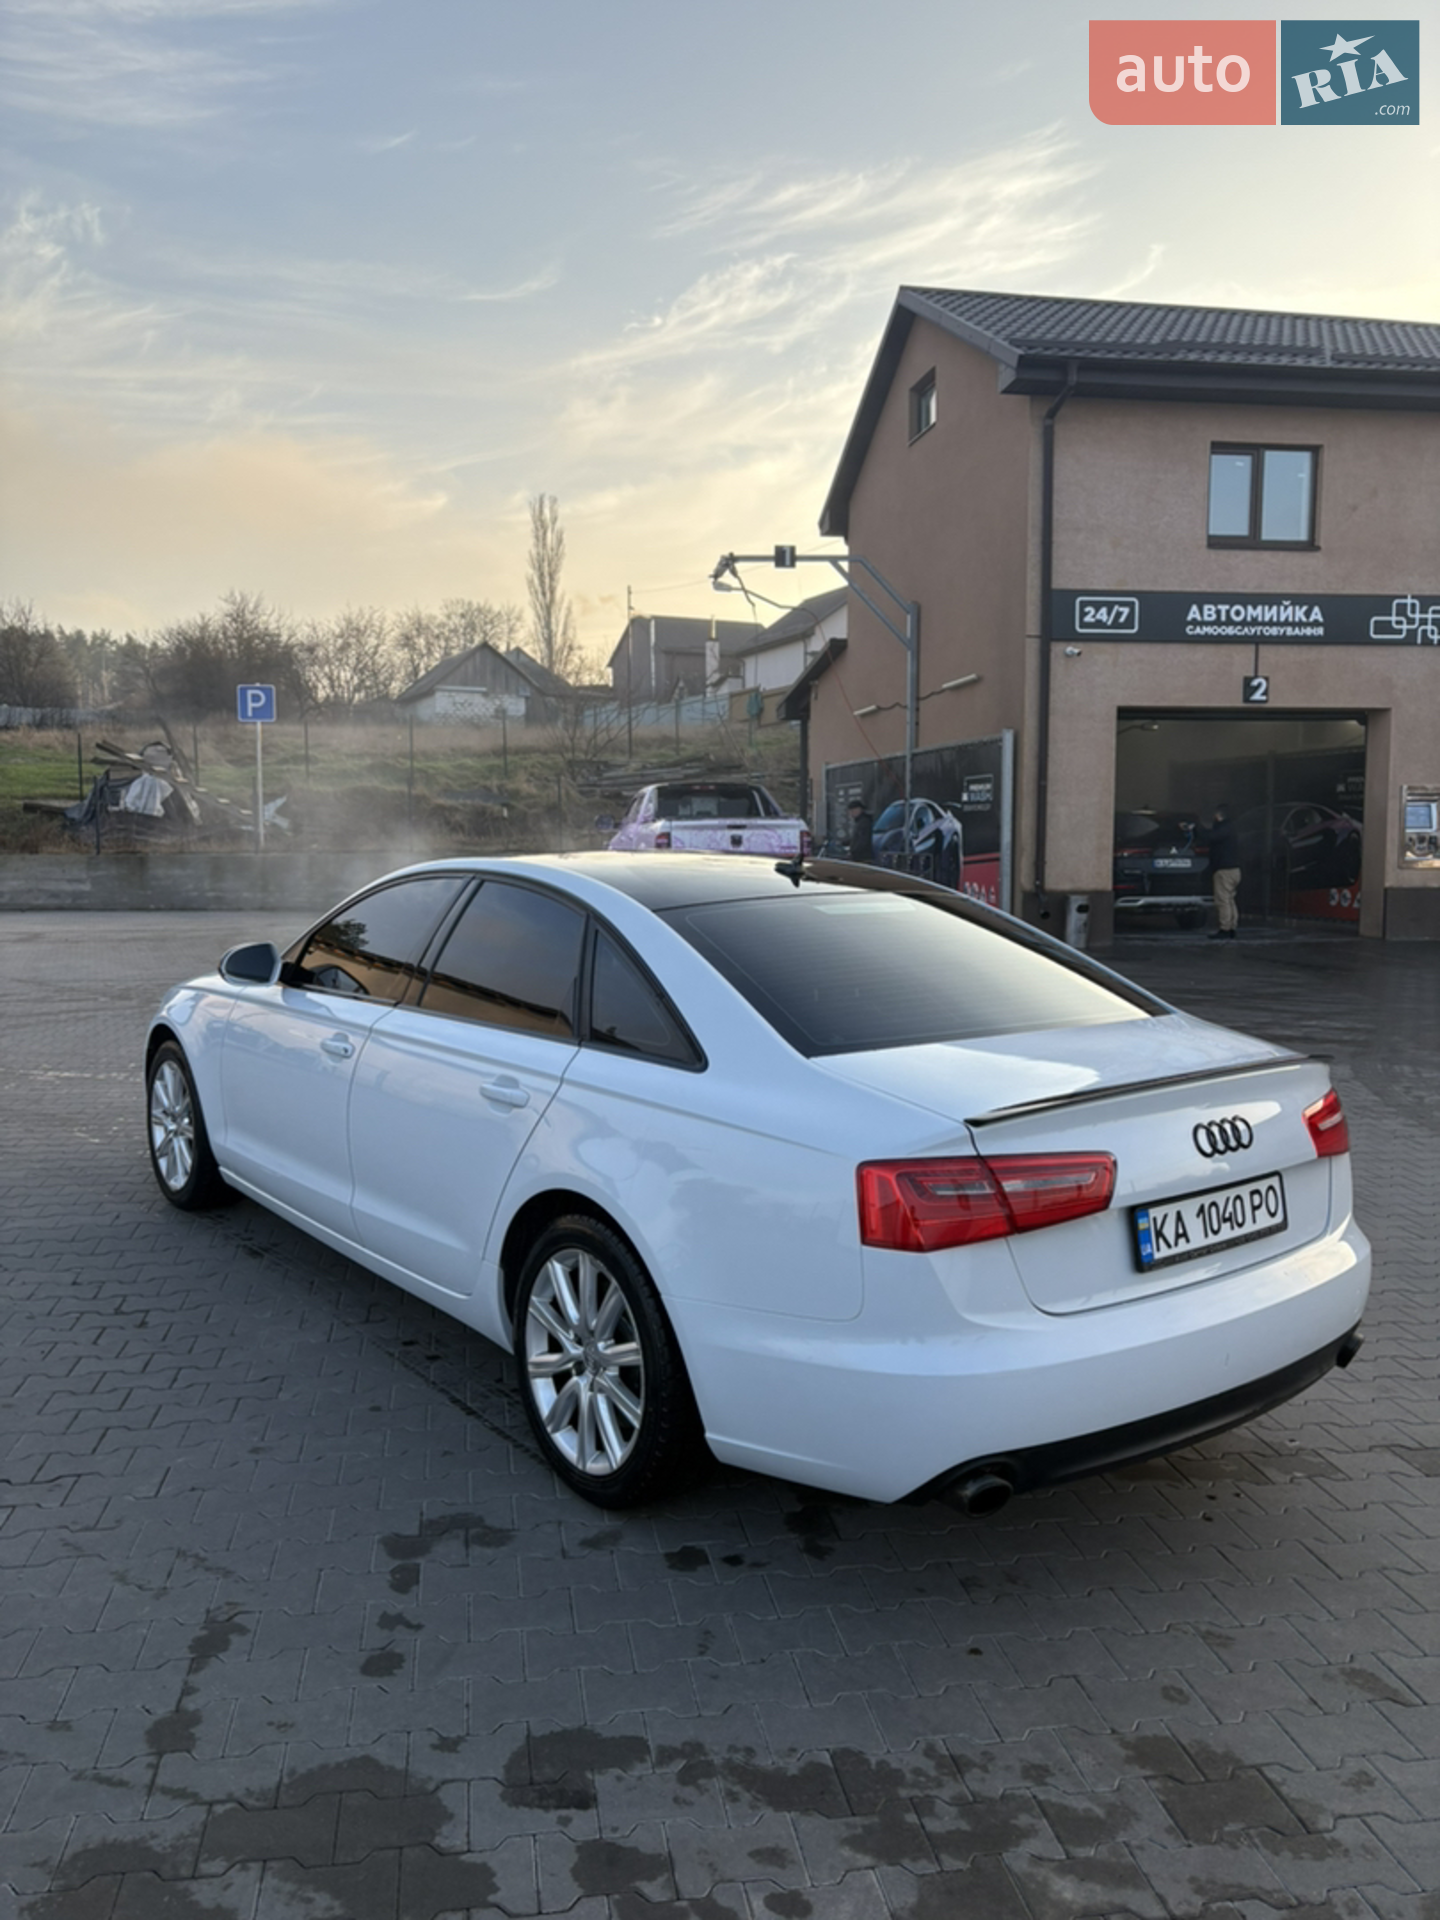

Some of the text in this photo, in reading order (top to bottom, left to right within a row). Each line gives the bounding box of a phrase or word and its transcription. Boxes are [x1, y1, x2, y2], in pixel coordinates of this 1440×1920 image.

[1082, 604, 1131, 626] 24/7
[1186, 600, 1324, 623] АВТОМИЙКА
[1185, 625, 1324, 637] САМООБСЛУГОВУВАННЯ
[1249, 677, 1267, 701] 2
[246, 689, 266, 717] P
[1152, 1209, 1191, 1252] KA
[1195, 1193, 1246, 1239] 1040
[1249, 1184, 1279, 1224] PO
